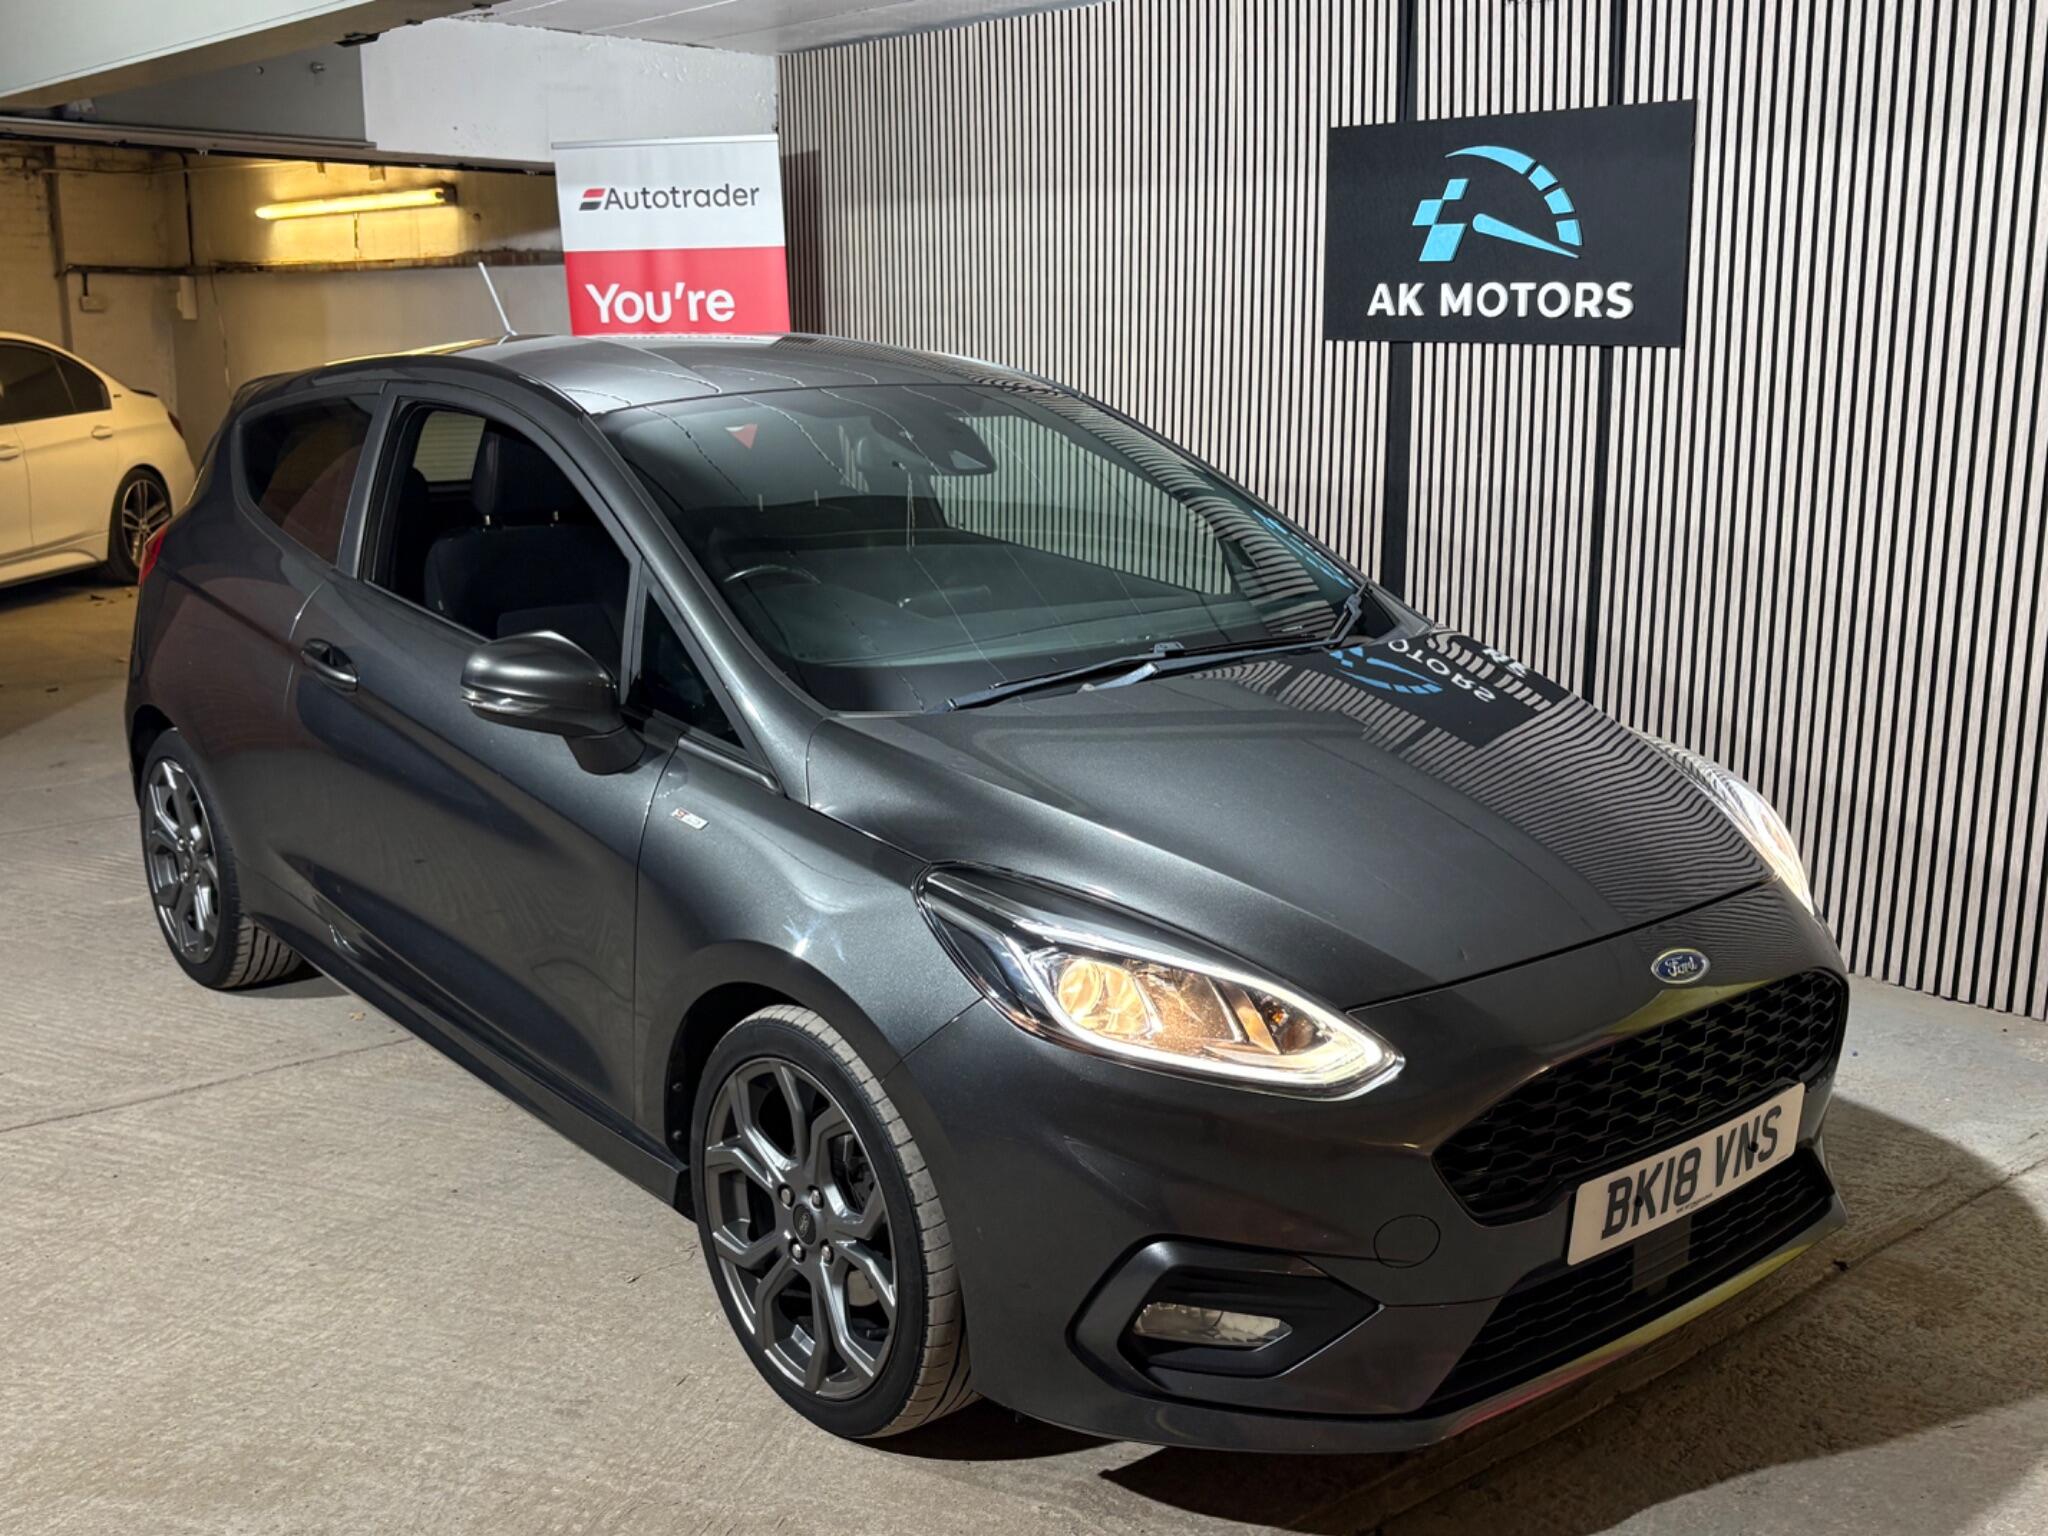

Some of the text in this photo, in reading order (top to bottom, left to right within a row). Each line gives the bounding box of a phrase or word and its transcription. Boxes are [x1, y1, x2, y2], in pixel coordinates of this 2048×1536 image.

[603, 183, 760, 210] Autotrader
[585, 281, 736, 324] You're
[1366, 281, 1635, 319] AK MOTORS
[1664, 954, 1698, 977] Ford
[1600, 1104, 1783, 1240] BK18 VNS
